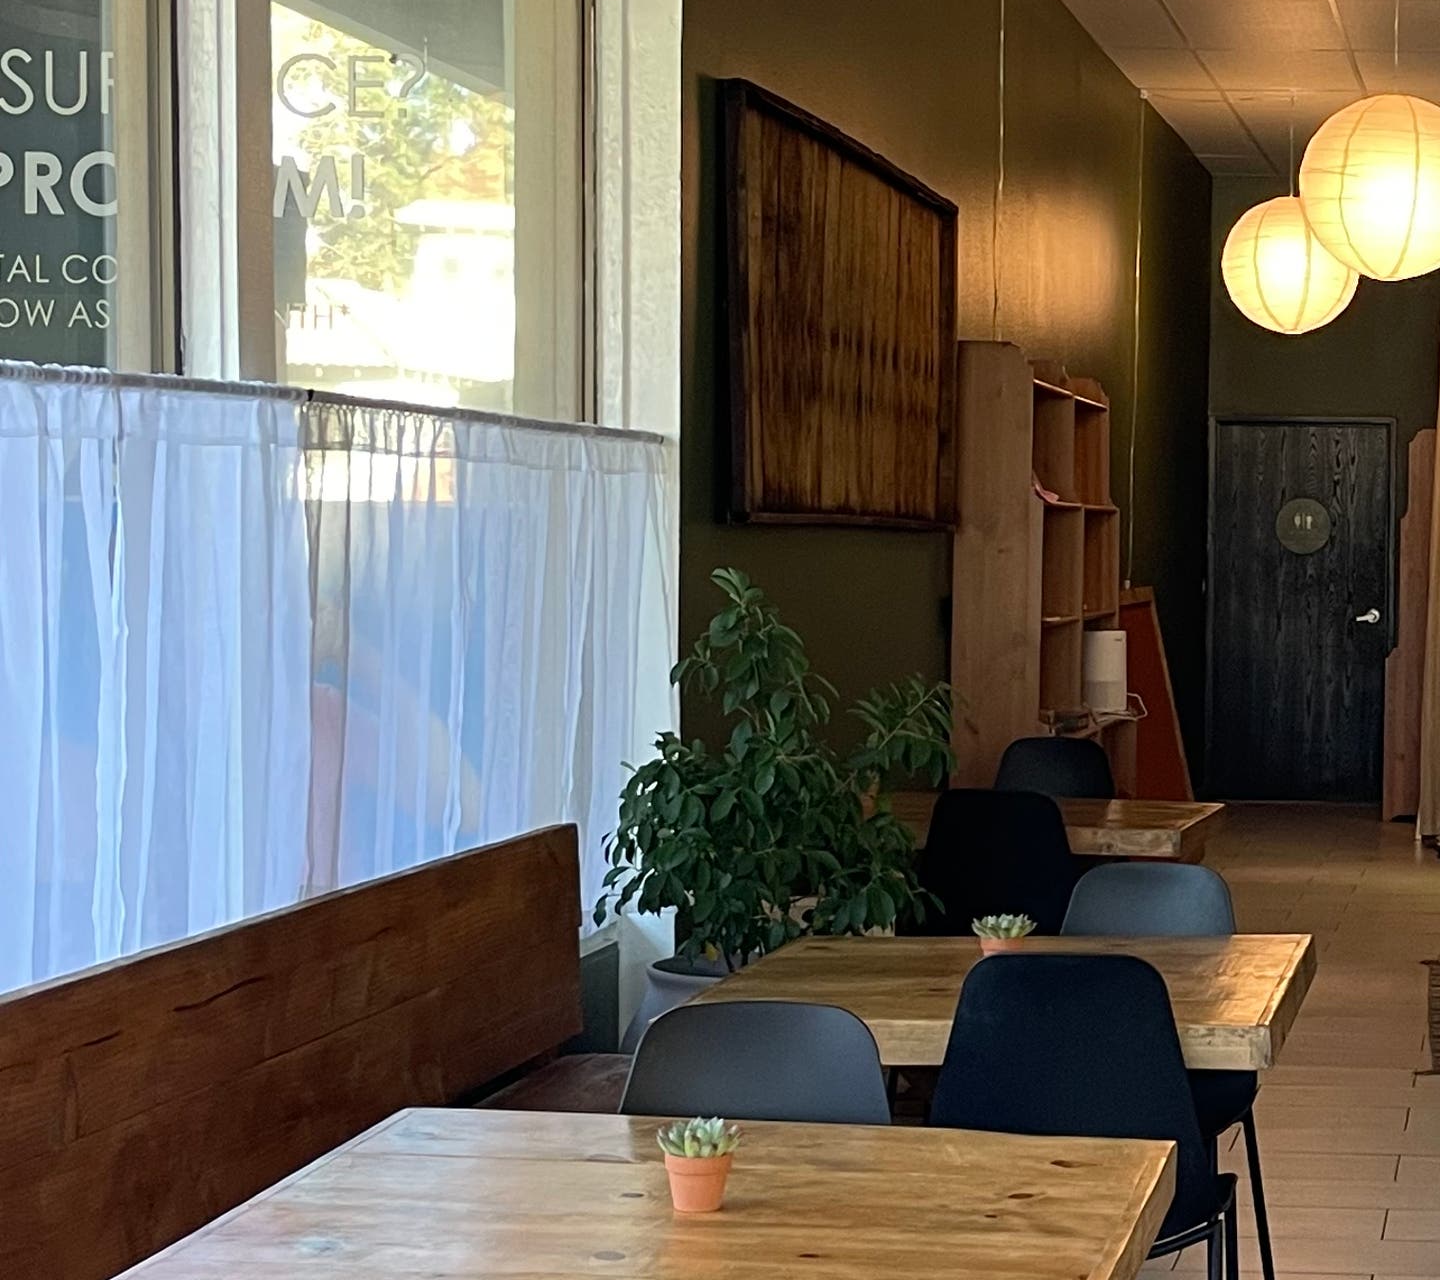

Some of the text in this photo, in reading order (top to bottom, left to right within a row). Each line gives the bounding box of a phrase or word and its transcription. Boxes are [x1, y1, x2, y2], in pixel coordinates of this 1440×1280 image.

[277, 53, 426, 118] CE?
[0, 254, 50, 283] AL
[68, 299, 110, 328] AS
